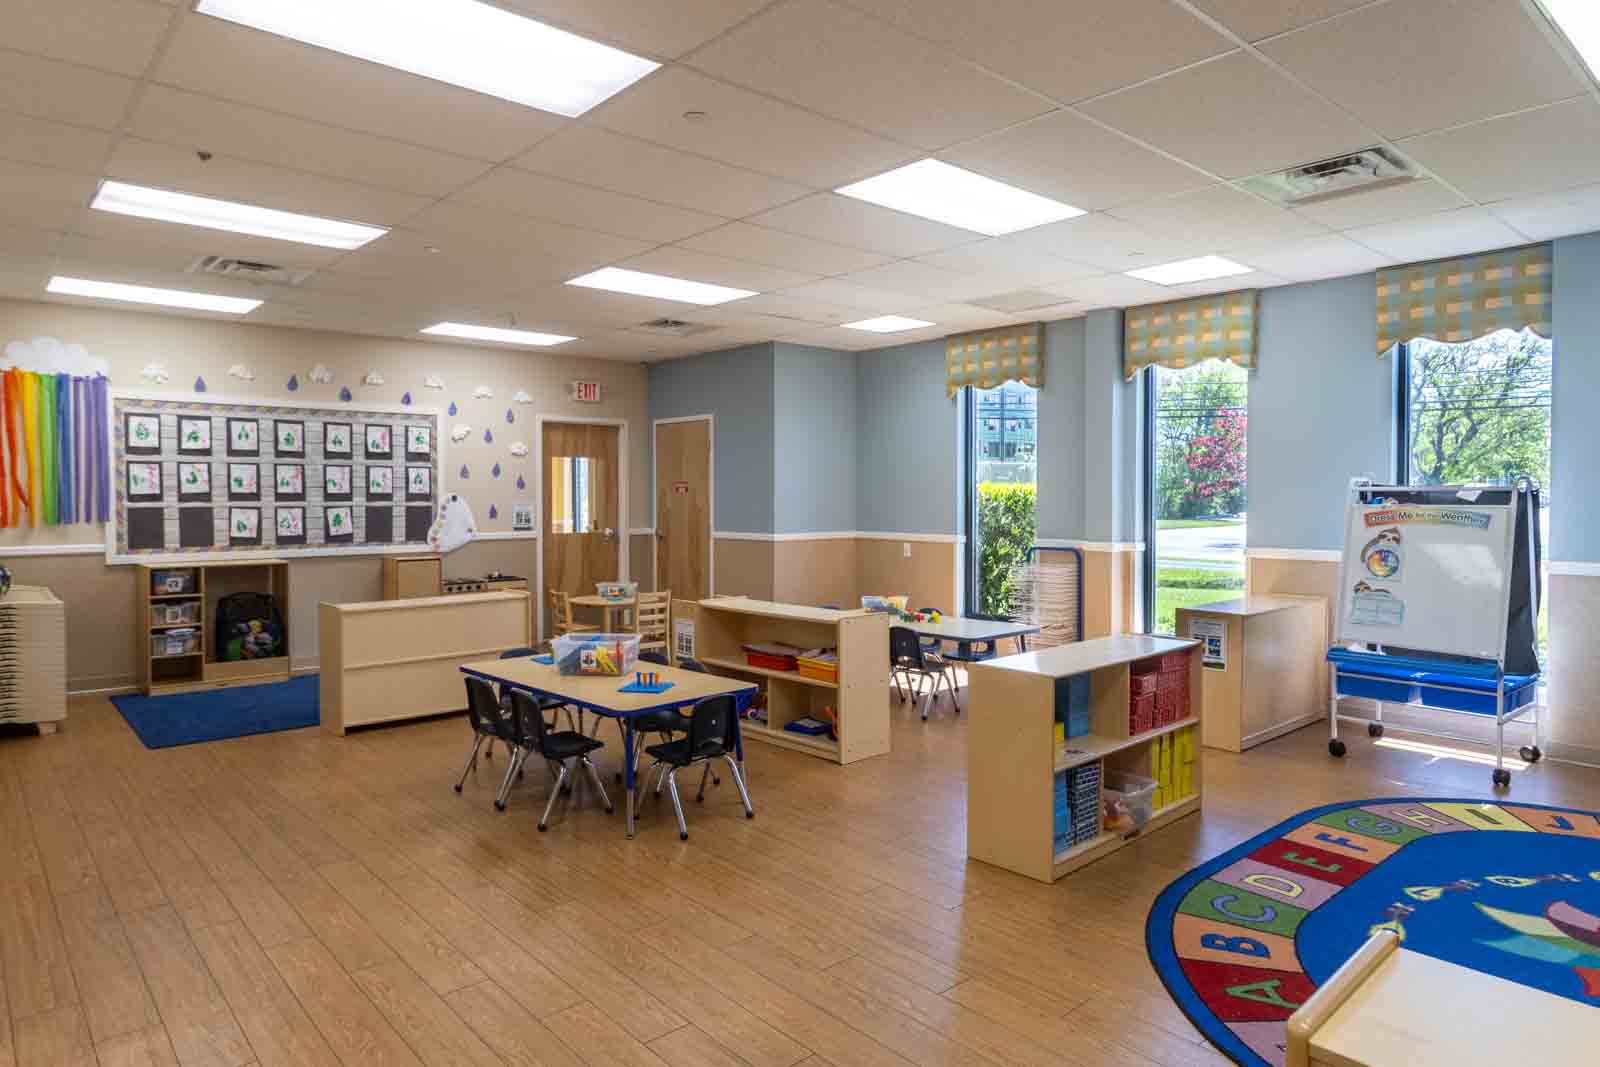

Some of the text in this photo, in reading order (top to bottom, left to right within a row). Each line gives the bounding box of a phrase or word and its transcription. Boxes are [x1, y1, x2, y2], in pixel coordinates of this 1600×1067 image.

[577, 383, 598, 400] EXIT
[1398, 511, 1413, 520] Me
[1346, 815, 1402, 835] G
[1392, 807, 1454, 828] H
[1314, 832, 1369, 853] F
[1282, 851, 1341, 873] E
[1244, 873, 1305, 899] D
[1211, 894, 1277, 923] C
[1200, 932, 1271, 958] B
[1226, 978, 1300, 1009] A
